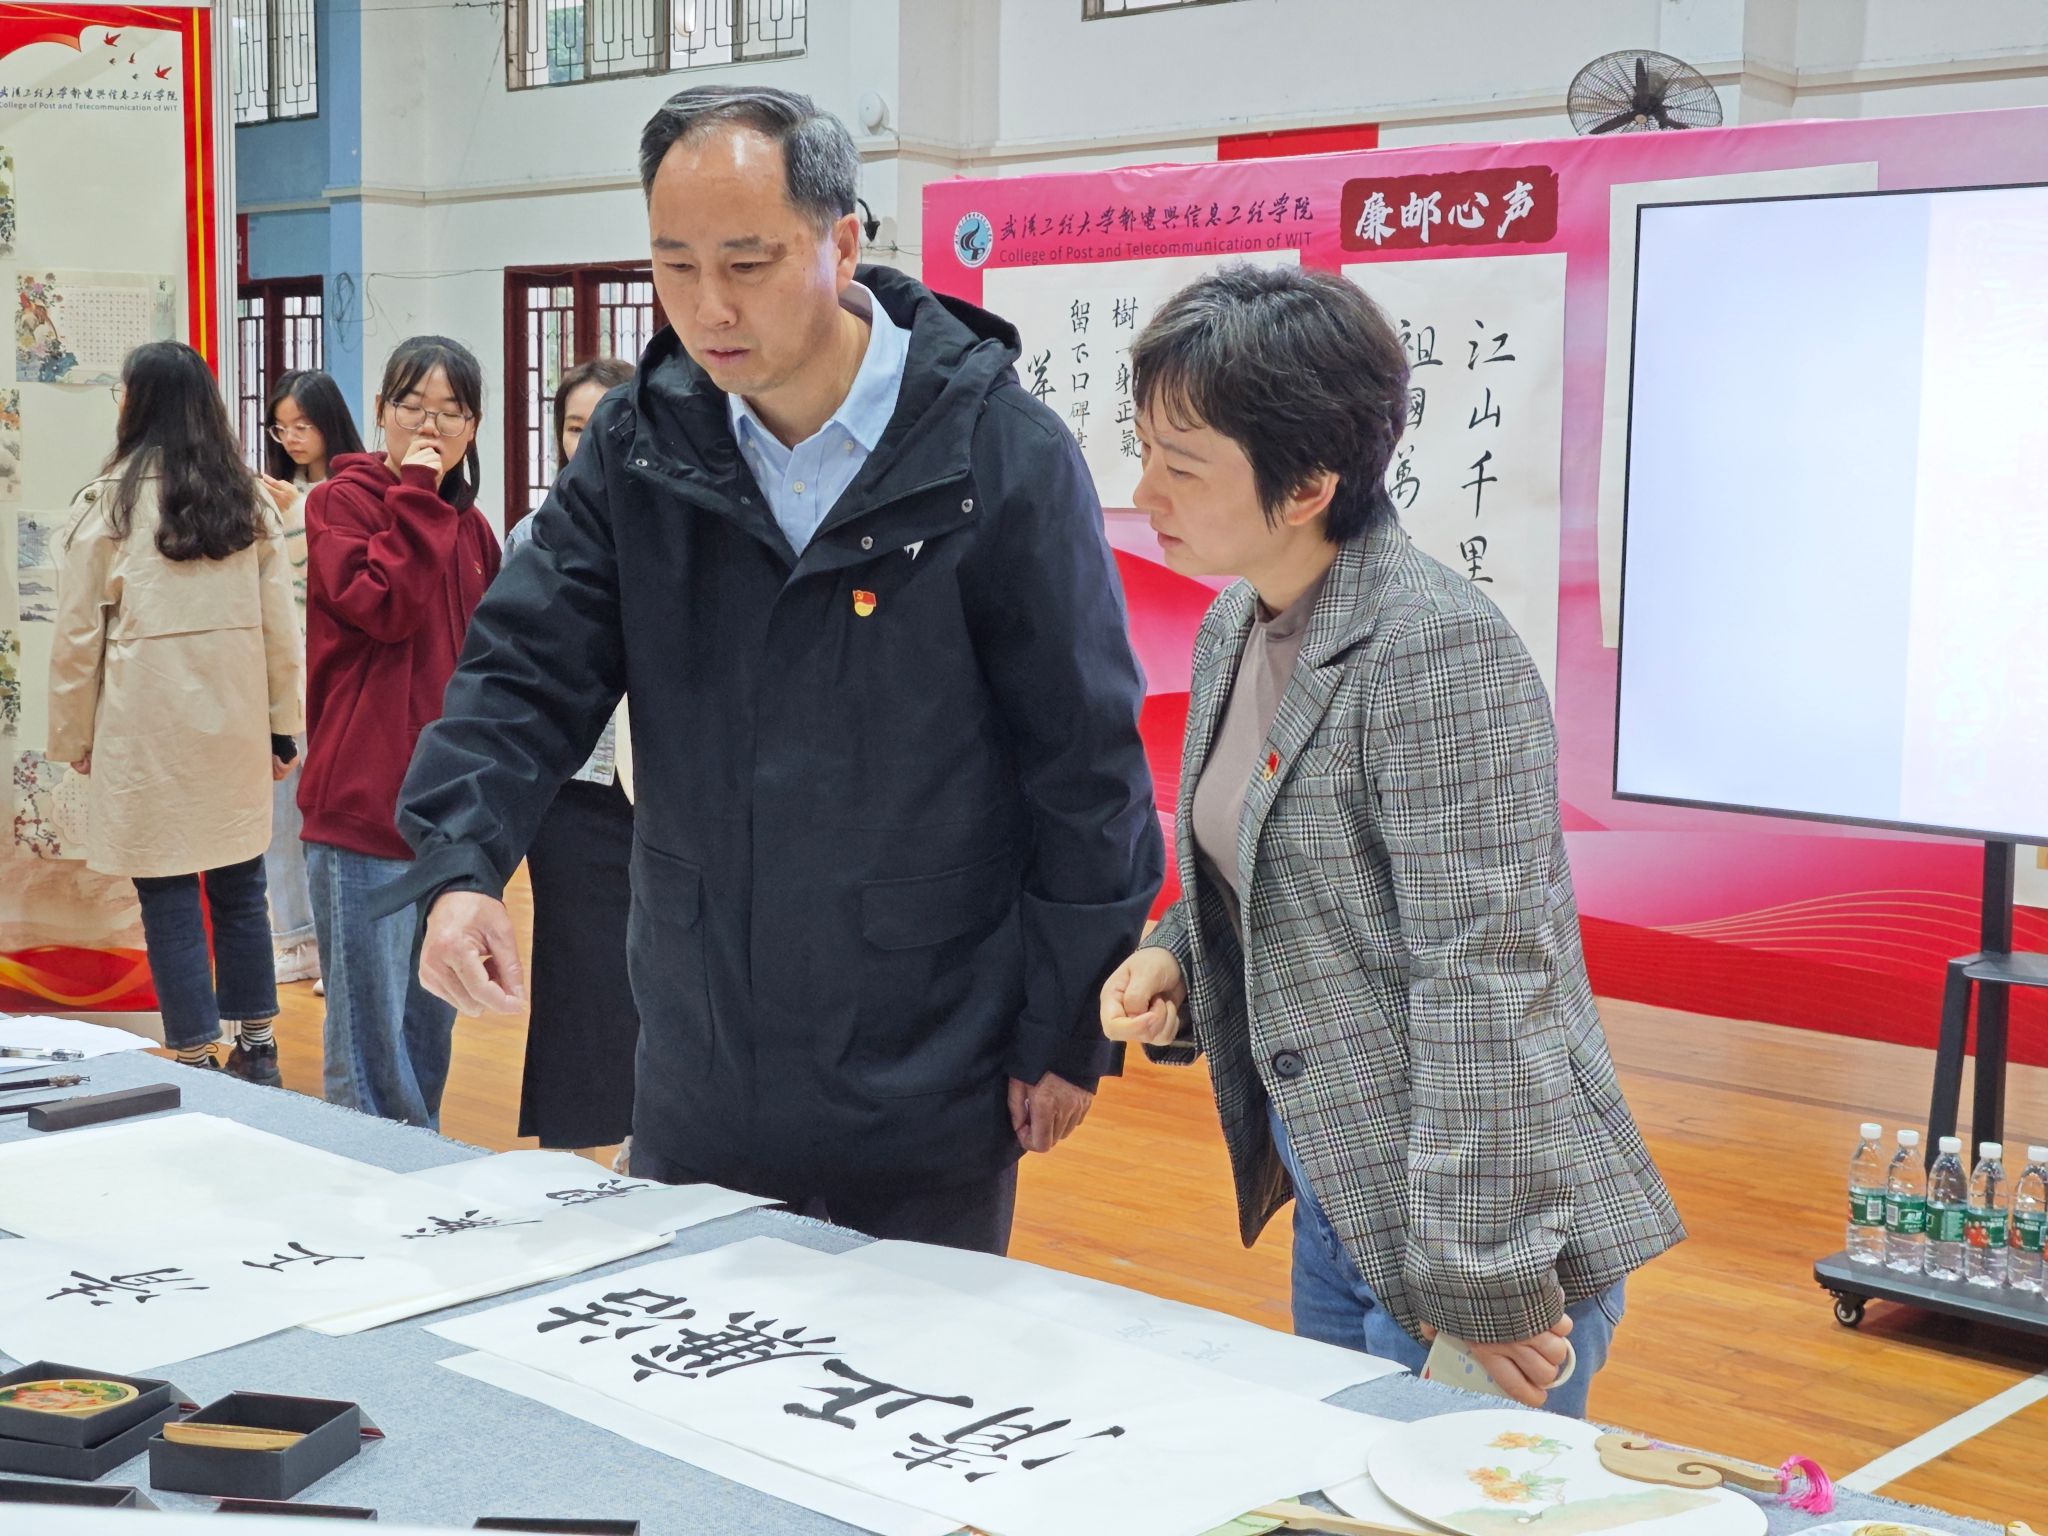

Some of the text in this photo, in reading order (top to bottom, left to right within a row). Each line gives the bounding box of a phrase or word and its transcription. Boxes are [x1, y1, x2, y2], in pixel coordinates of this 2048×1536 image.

[58, 102, 72, 110] and
[75, 103, 152, 111] Telecommunication
[1355, 181, 1534, 245] 廉邮心声
[1000, 232, 1312, 265] College of Post and Telecommunication of WIT
[1389, 319, 1443, 539] 祖國萬
[1461, 319, 1516, 583] 江山千里
